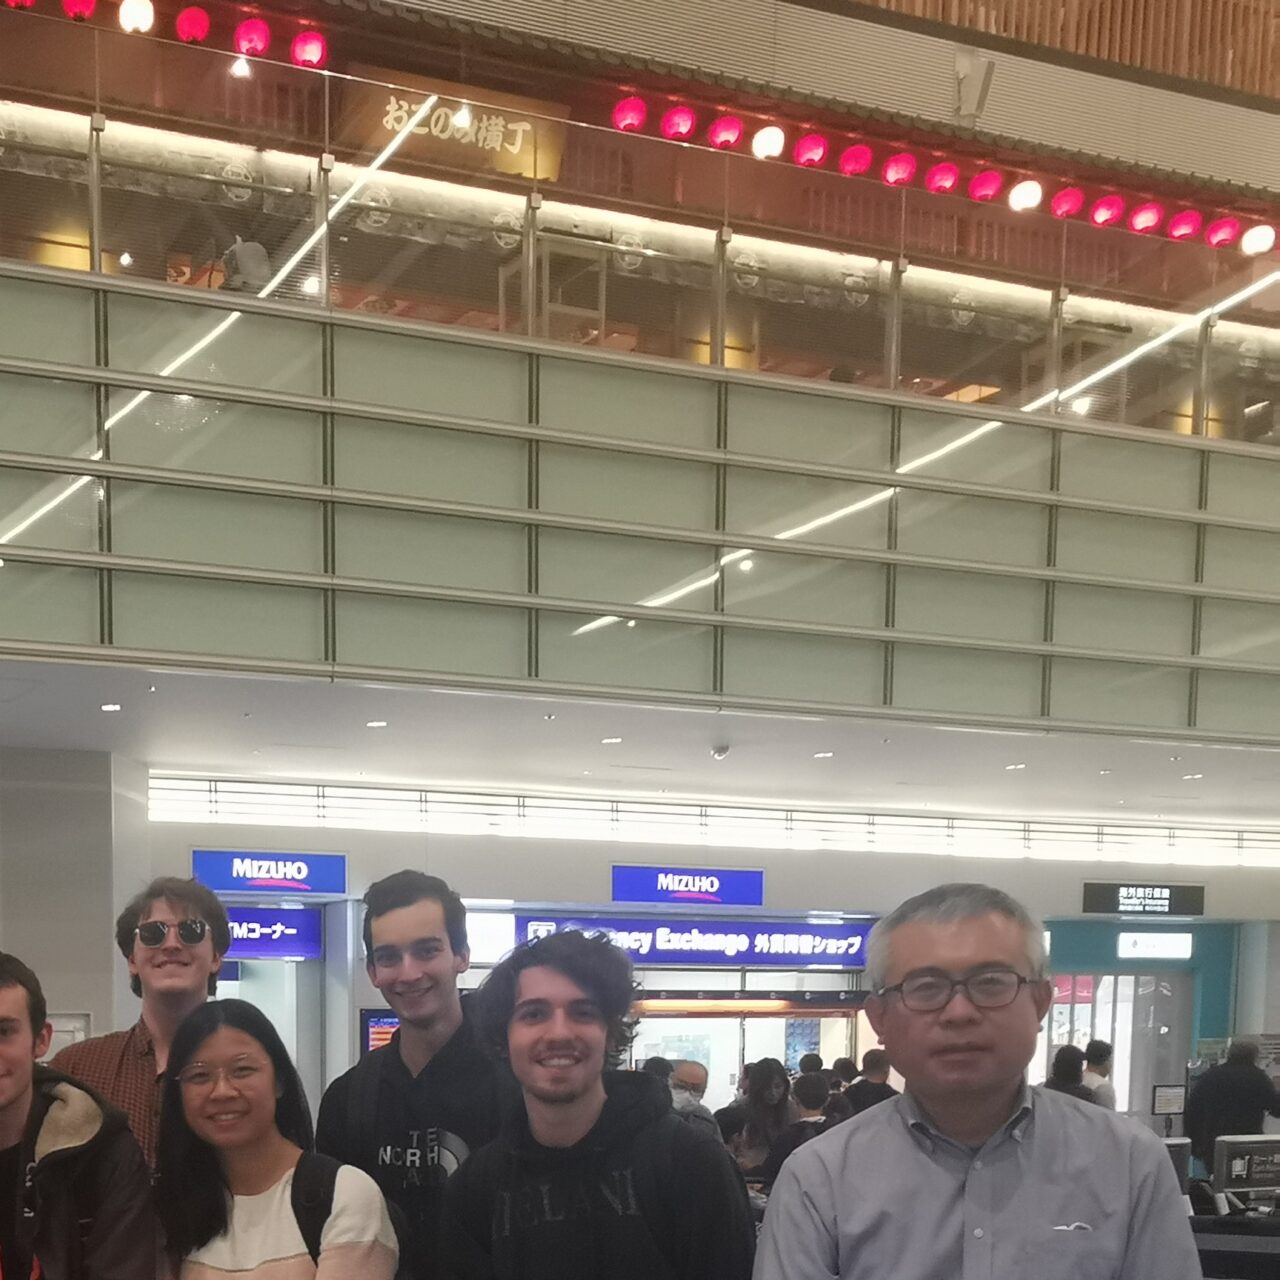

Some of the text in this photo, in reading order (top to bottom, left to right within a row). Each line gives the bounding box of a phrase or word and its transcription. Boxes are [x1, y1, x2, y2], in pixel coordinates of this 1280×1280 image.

[232, 858, 309, 880] MIZUHO
[657, 873, 720, 893] MIZUHO
[655, 927, 750, 956] Exchange
